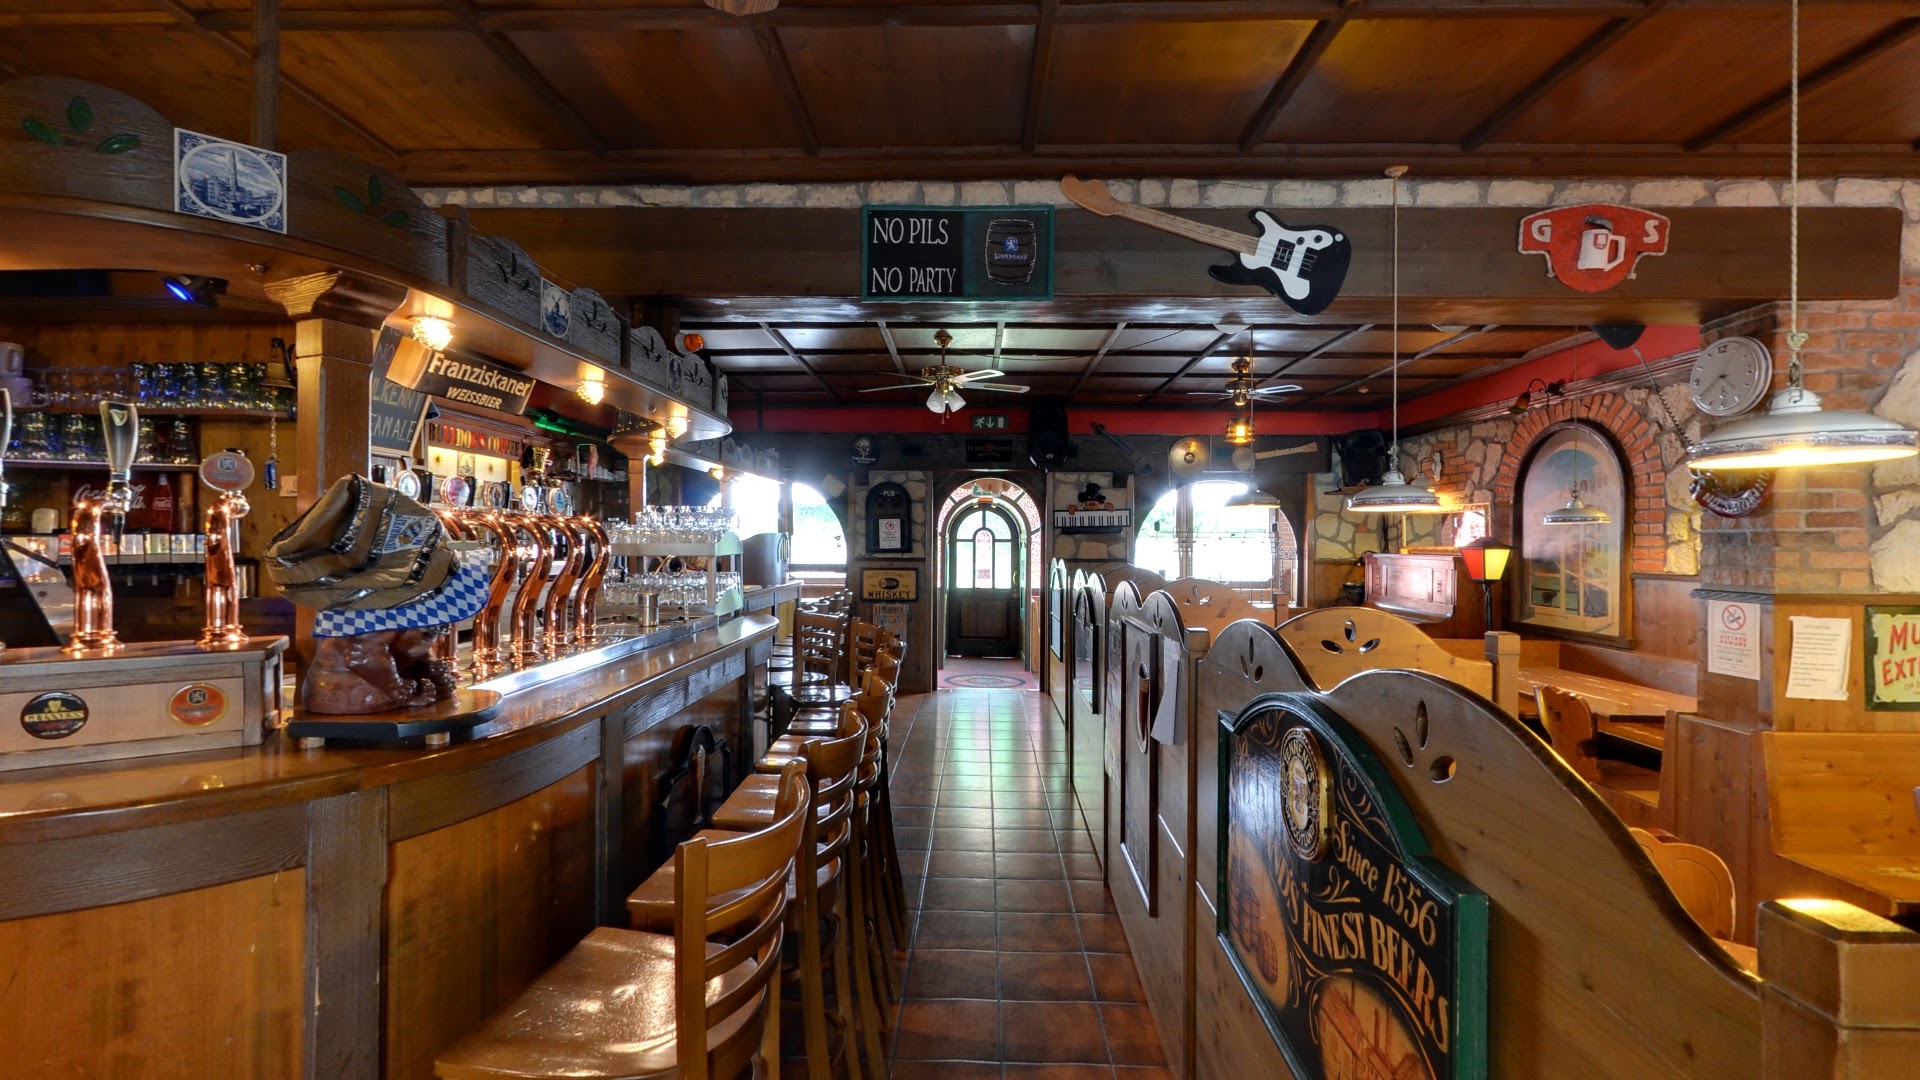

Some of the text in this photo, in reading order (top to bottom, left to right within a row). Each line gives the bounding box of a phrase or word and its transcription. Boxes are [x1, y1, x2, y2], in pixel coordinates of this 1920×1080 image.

[873, 218, 949, 245] NO PILS
[1531, 218, 1660, 244] G S
[871, 267, 957, 294] NO PARTY
[427, 352, 532, 397] Franziskaner
[371, 377, 426, 413] ILKENNY
[445, 386, 503, 410] WEISSBIER
[867, 590, 911, 599] WHISKEY
[1882, 656, 1920, 686] EXT
[24, 711, 85, 723] GUINNESS
[1333, 820, 1379, 892] Since
[1383, 863, 1437, 947] 1556
[1303, 900, 1449, 1054] FINEST BEERS
